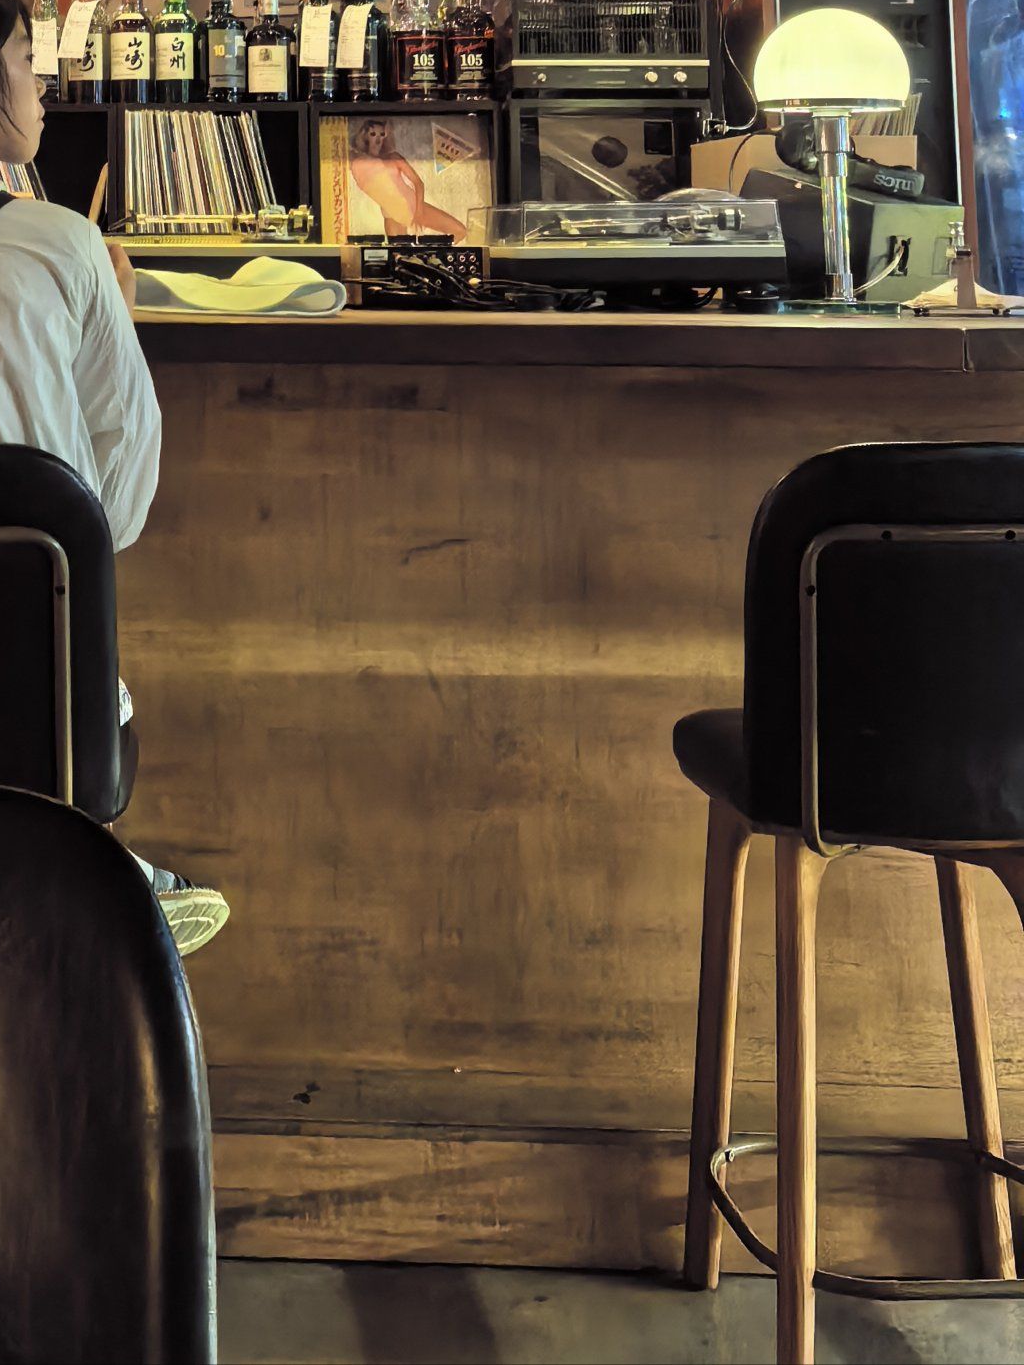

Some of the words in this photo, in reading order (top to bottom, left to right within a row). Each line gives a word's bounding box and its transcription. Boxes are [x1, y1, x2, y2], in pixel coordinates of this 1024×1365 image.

[125, 37, 146, 72] 山崎
[170, 37, 186, 72] 白州
[213, 44, 225, 58] 10
[413, 53, 435, 66] 105
[460, 53, 483, 66] 105
